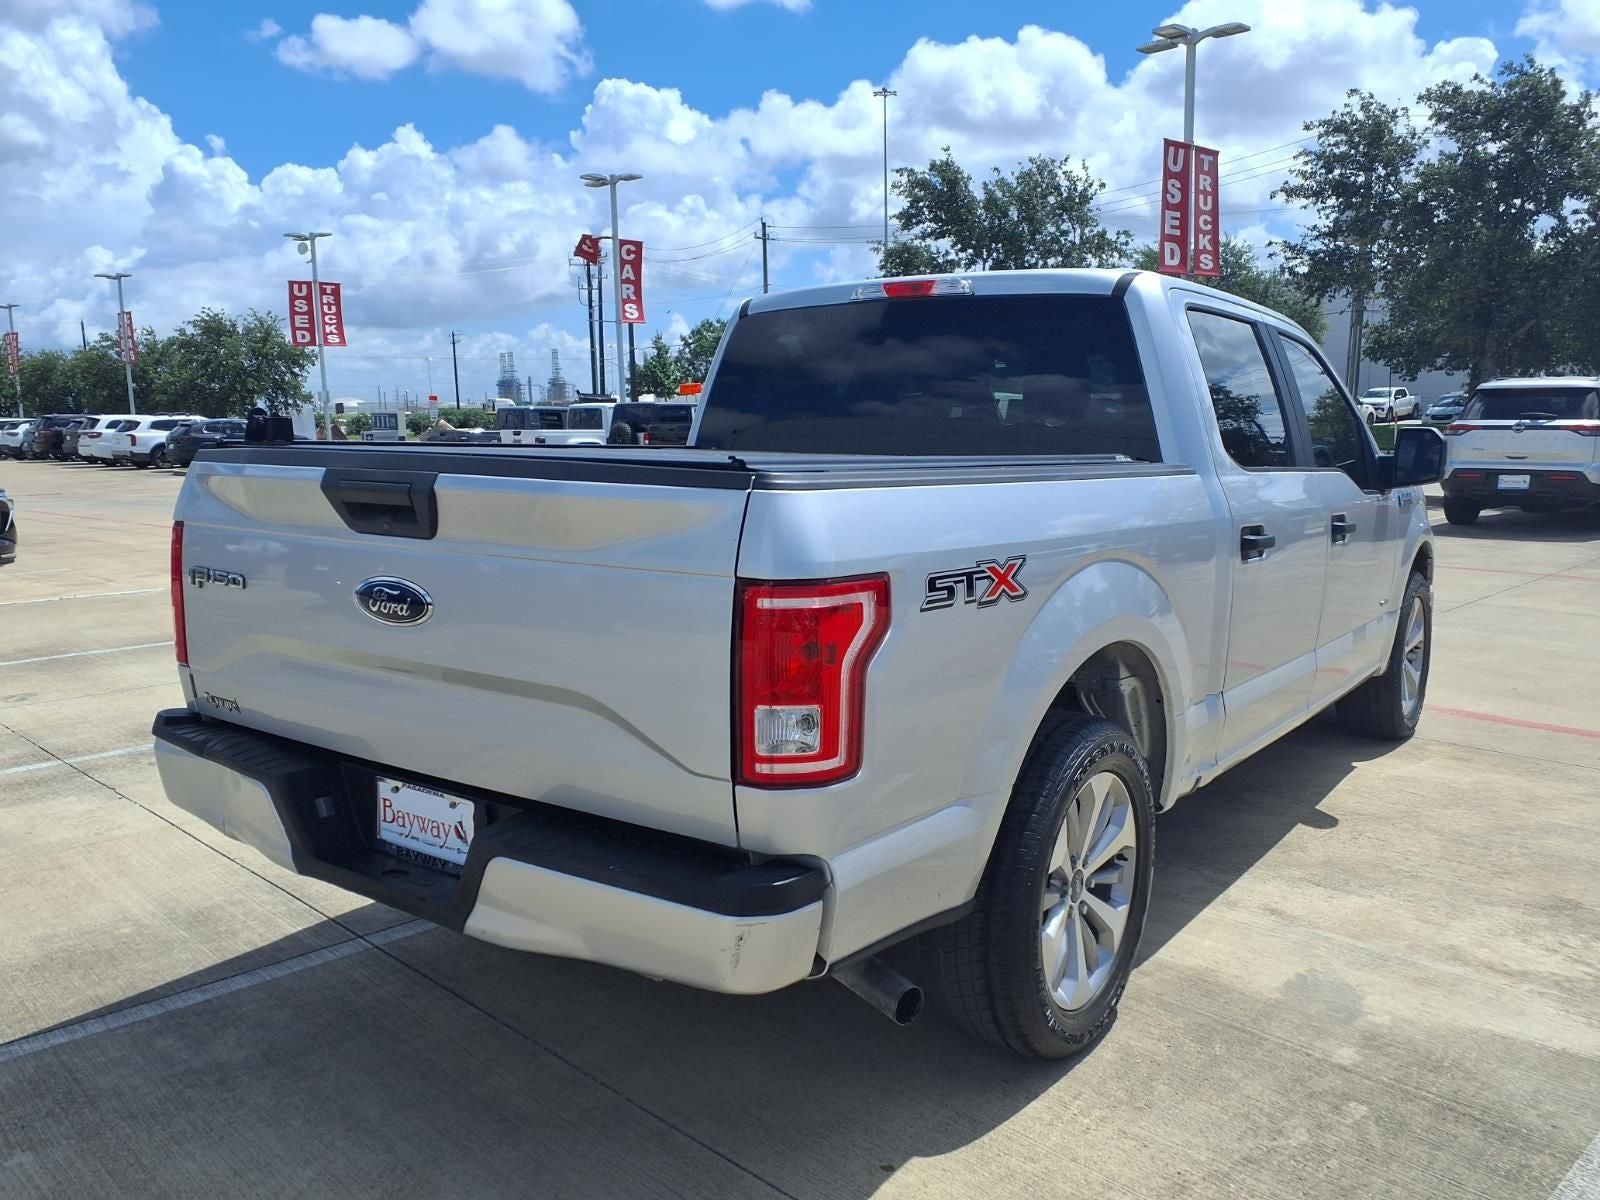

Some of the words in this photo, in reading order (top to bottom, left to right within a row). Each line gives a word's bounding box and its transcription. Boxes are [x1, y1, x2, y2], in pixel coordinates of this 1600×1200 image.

[1165, 146, 1184, 266] USED
[1199, 154, 1213, 269] TRUCKS
[620, 244, 639, 319] CARS
[293, 283, 311, 343] USED
[322, 284, 341, 343] TRUCKS
[368, 585, 412, 617] Ford
[920, 554, 1030, 613] STX
[381, 797, 452, 849] Bayway
